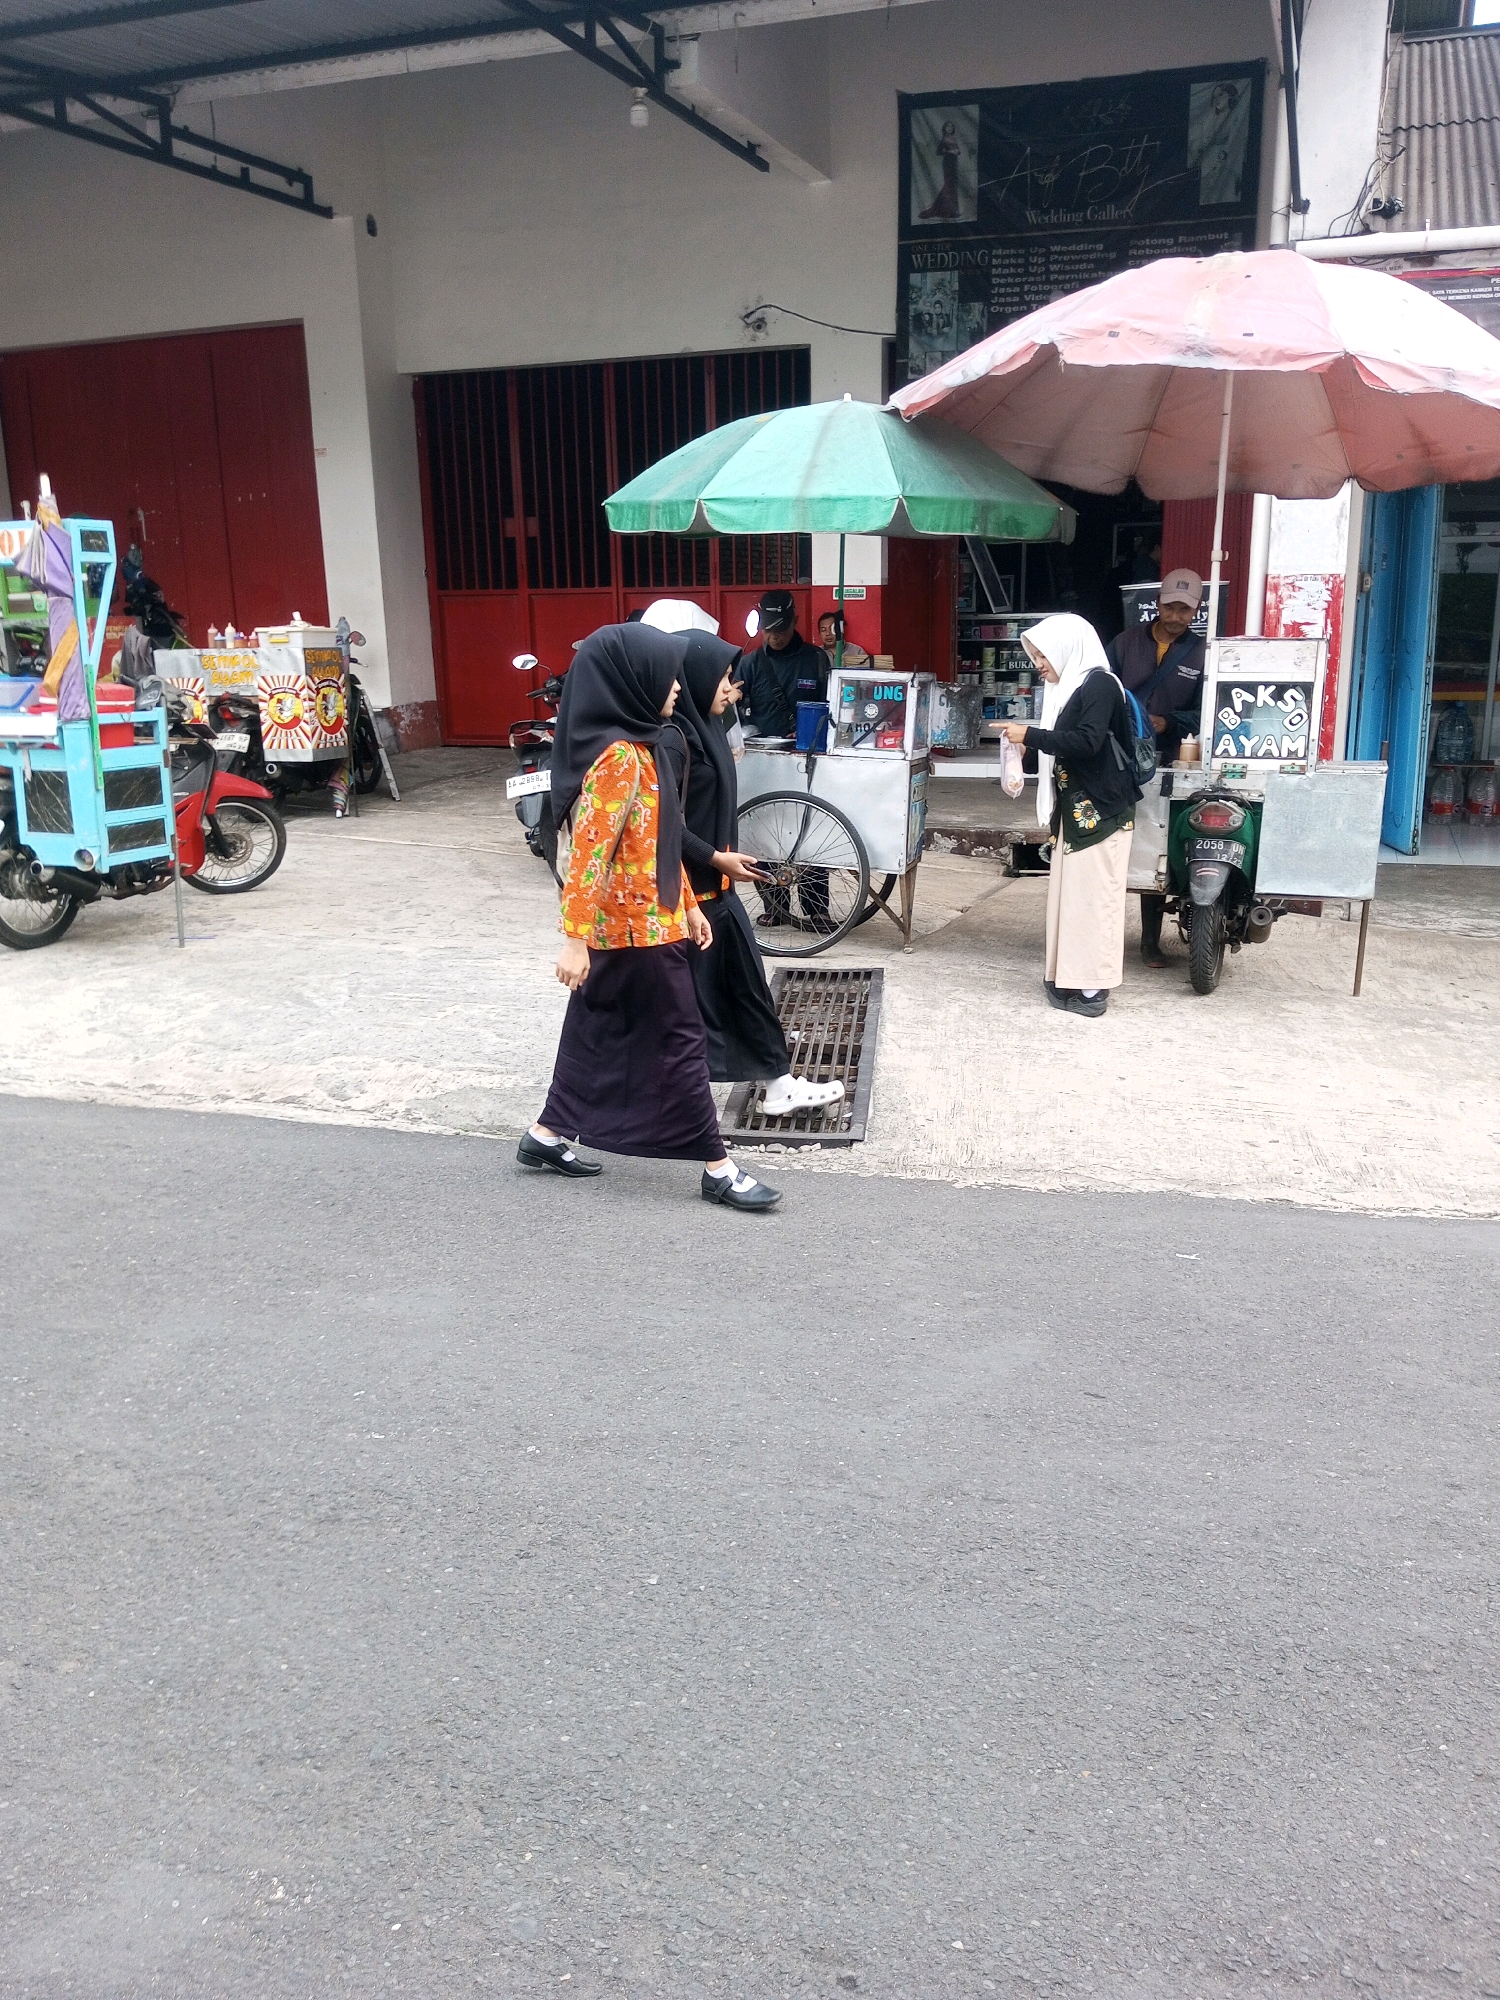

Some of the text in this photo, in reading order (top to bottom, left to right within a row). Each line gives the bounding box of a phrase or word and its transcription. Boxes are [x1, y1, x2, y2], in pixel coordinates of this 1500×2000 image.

[1026, 204, 1134, 227] Wedding Gallery
[992, 242, 1104, 256] Make Up Wedding
[911, 249, 989, 270] WEDDING
[992, 257, 1025, 266] Make
[1029, 254, 1046, 264] Up
[991, 266, 1025, 275] Make
[1028, 264, 1046, 273] Up
[1217, 684, 1309, 733] BAKSO
[1214, 733, 1306, 758] AYAM
[1195, 839, 1224, 850] 2058
